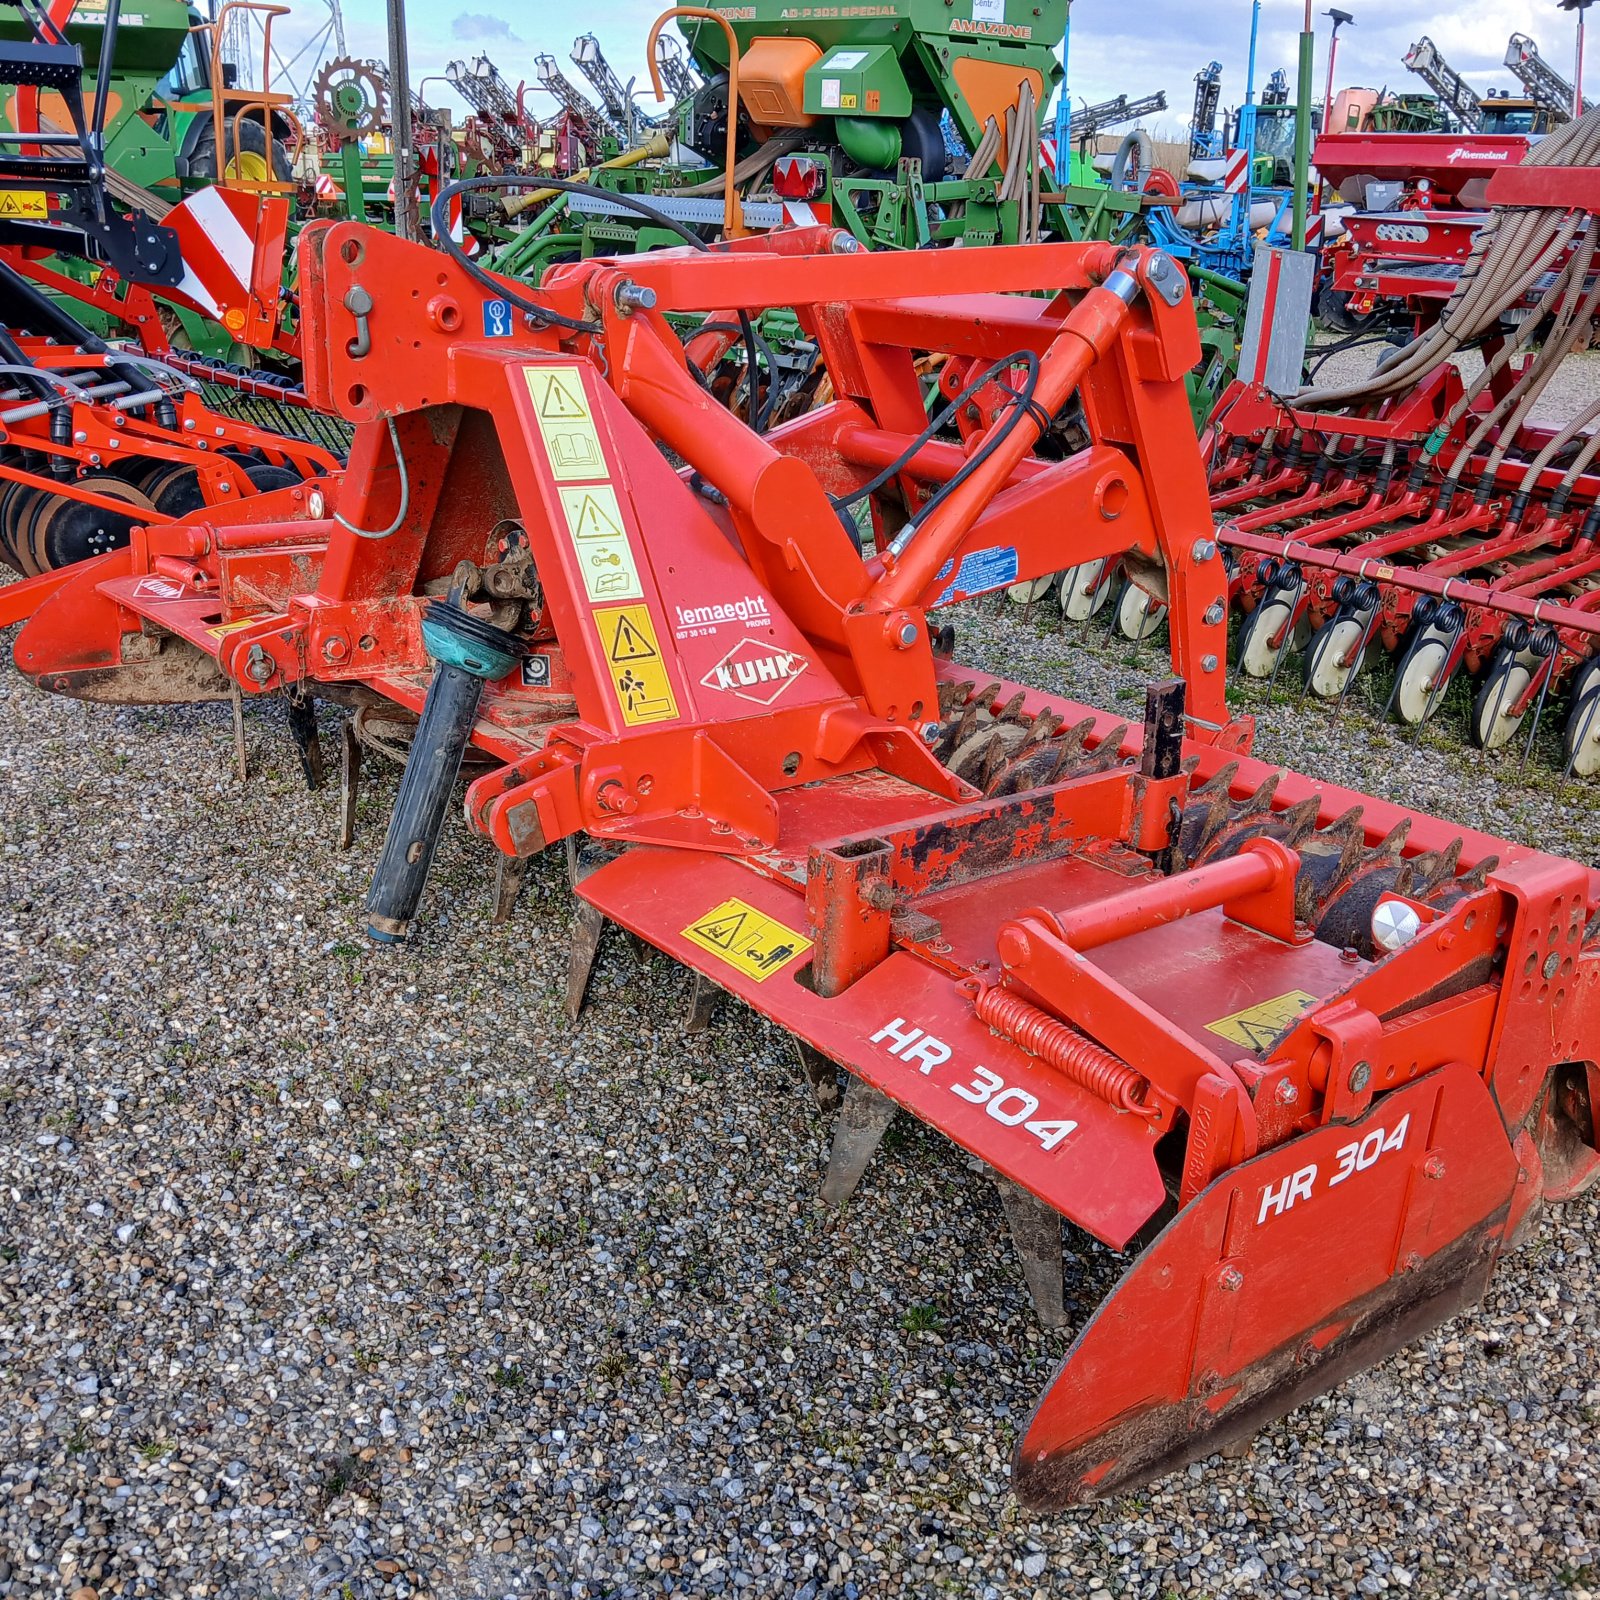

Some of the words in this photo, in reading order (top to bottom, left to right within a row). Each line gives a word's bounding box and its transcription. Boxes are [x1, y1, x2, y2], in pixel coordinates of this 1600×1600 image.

[813, 7, 838, 17] 303
[841, 5, 898, 17] SPECIAL
[949, 18, 1032, 39] AMAZONE
[1461, 150, 1508, 160] Kverneland
[140, 580, 181, 598] KUHN
[699, 628, 708, 636] 12
[715, 653, 799, 691] KUHN
[869, 1017, 952, 1076] HR
[950, 1065, 1078, 1151] 304
[1256, 1163, 1318, 1226] HR
[1329, 1112, 1410, 1187] 304
